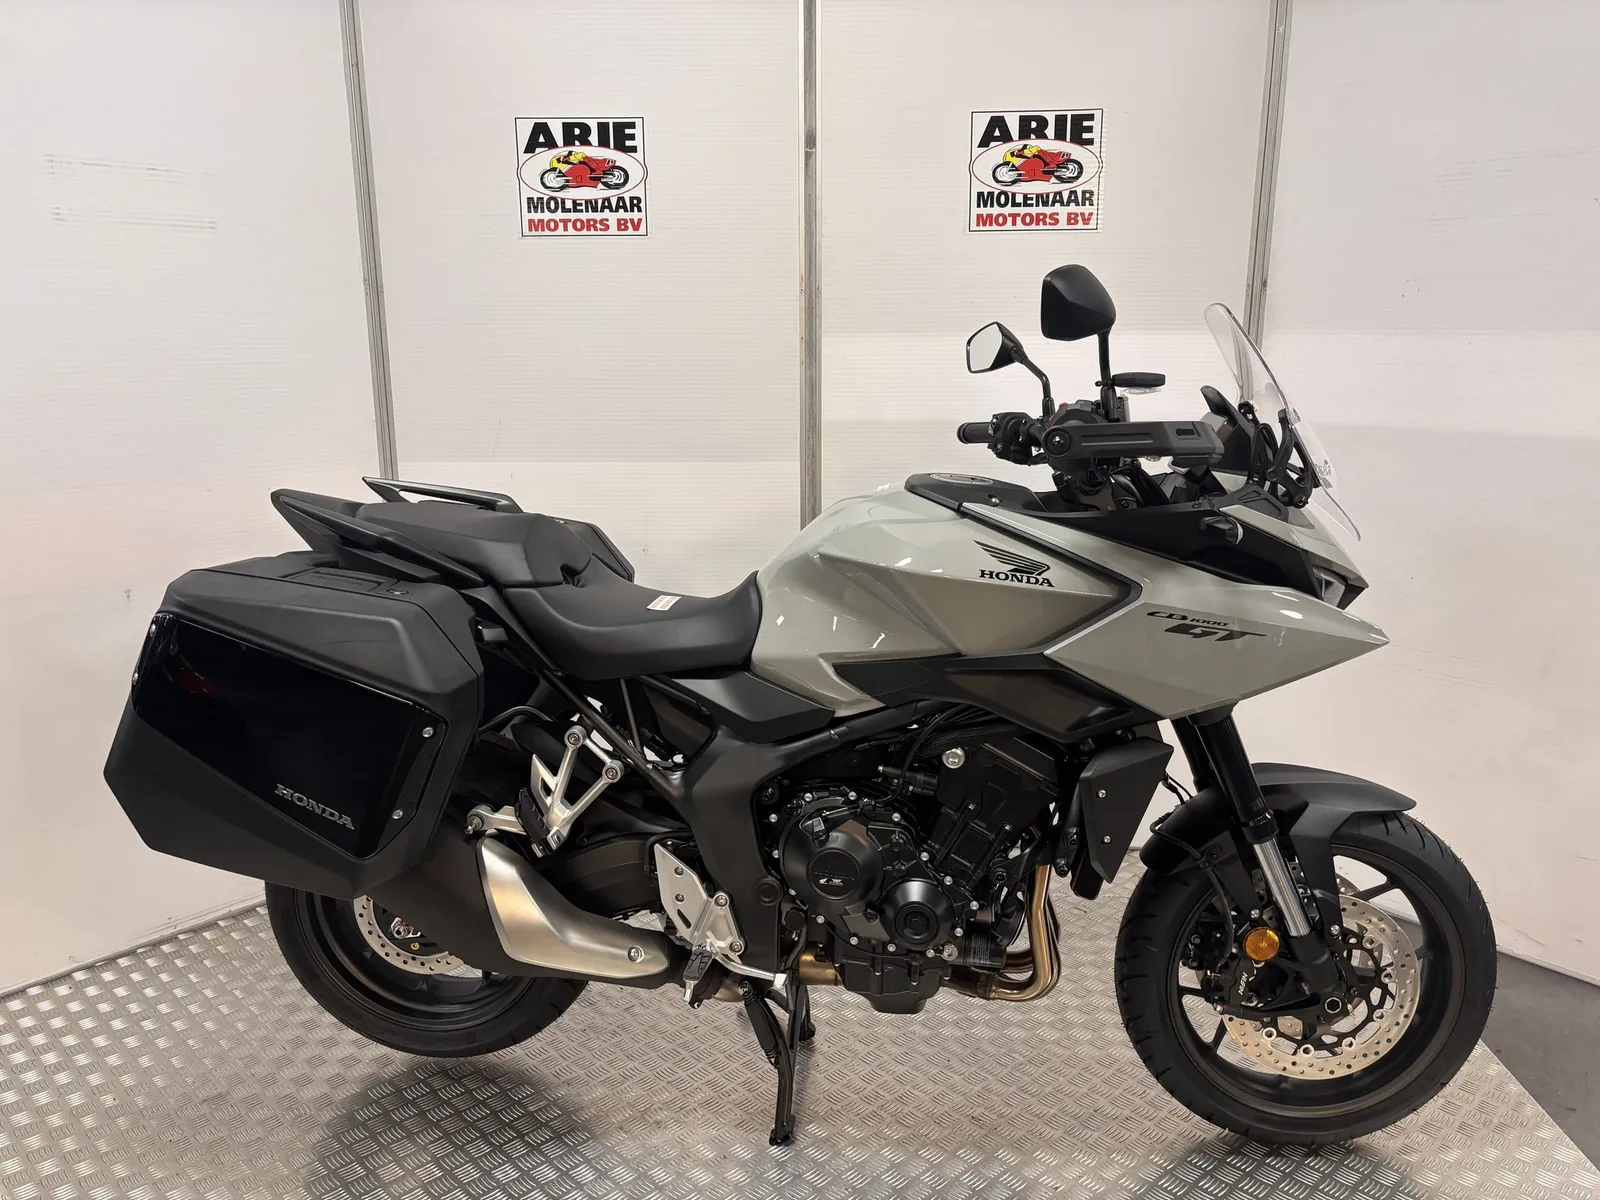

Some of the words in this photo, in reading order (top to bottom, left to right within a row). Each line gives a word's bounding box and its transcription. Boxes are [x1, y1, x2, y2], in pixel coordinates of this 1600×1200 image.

[523, 121, 638, 154] ARIE
[977, 113, 1095, 148] ARIE
[526, 195, 643, 214] MOLENAAR
[976, 189, 1095, 208] MOLENAAR
[528, 218, 611, 232] MOTORS
[616, 217, 643, 232] BV
[975, 212, 1060, 227] MOTORS
[1066, 211, 1094, 226] BV
[979, 569, 1055, 588] HONDA
[1164, 622, 1269, 642] GT
[274, 783, 355, 831] HONDA
